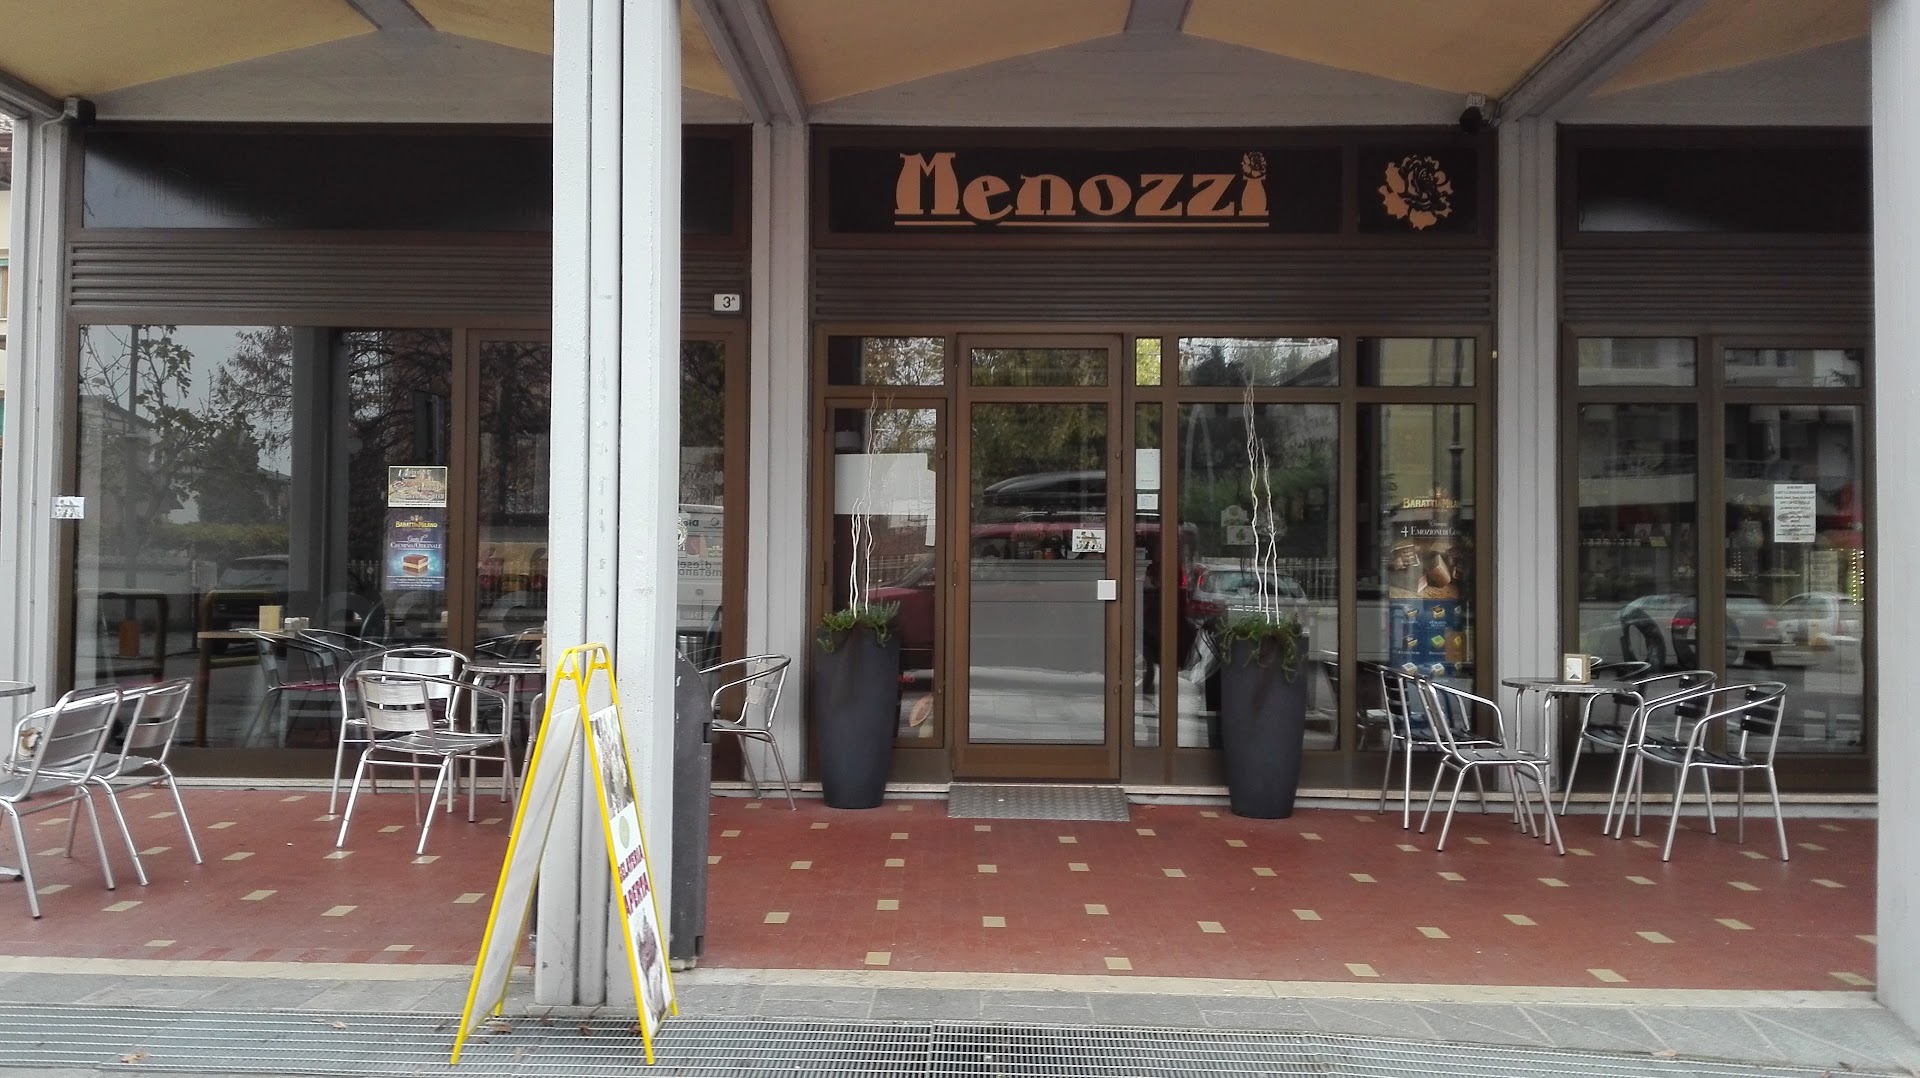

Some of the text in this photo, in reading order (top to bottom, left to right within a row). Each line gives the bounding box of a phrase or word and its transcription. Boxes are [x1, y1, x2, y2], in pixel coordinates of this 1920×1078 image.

[895, 151, 1270, 220] Menozzi
[1403, 498, 1437, 508] BARATTI
[1400, 525, 1409, 537] 4
[623, 871, 651, 919] APERTA
